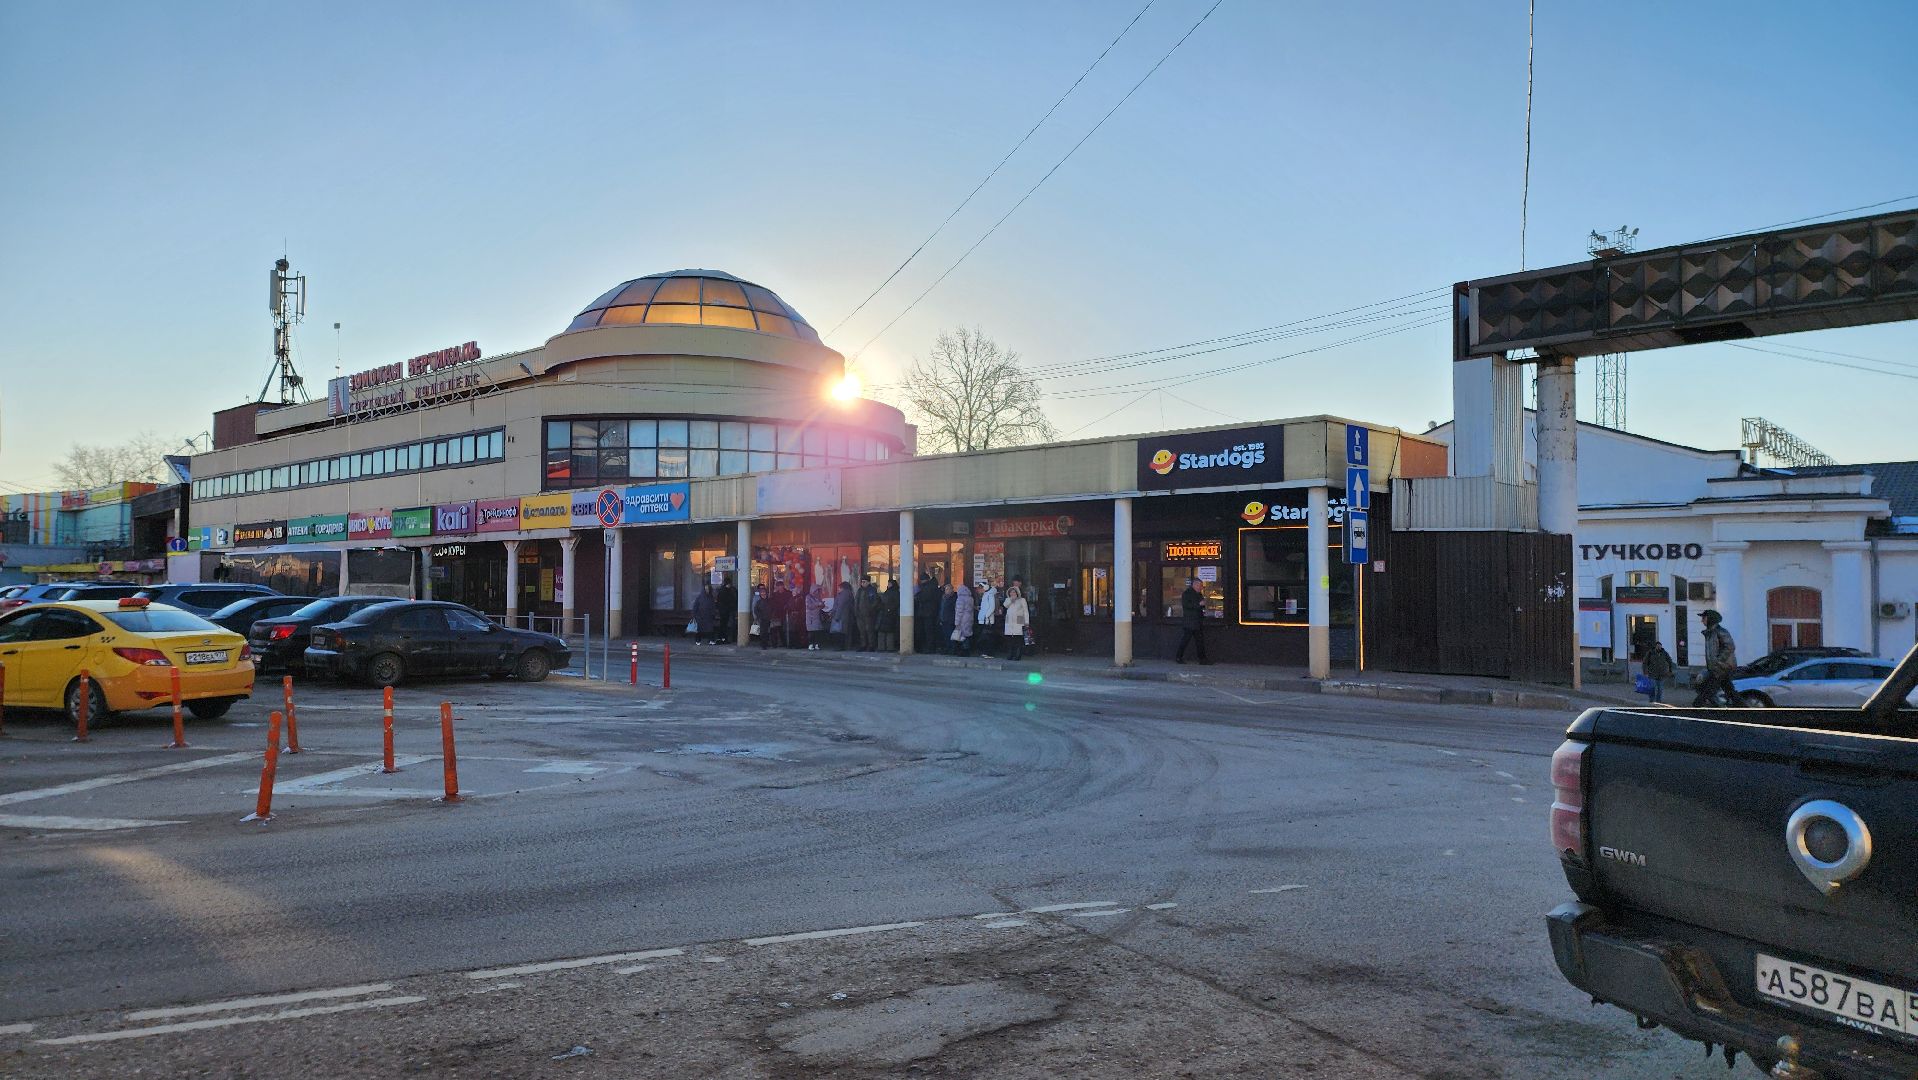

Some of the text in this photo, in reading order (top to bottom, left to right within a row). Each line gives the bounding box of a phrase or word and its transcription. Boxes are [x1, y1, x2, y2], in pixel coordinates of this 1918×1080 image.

[408, 341, 481, 376] ВЕРТИКАЛЬ
[1179, 449, 1265, 470] Stardogs
[625, 493, 668, 507] здравсити
[436, 506, 468, 530] kari
[983, 519, 1055, 536] Табакерка
[1169, 546, 1219, 556] ПОНЧИКИ
[1579, 543, 1703, 560] ТУЧКОВО
[1600, 846, 1647, 867] GWM
